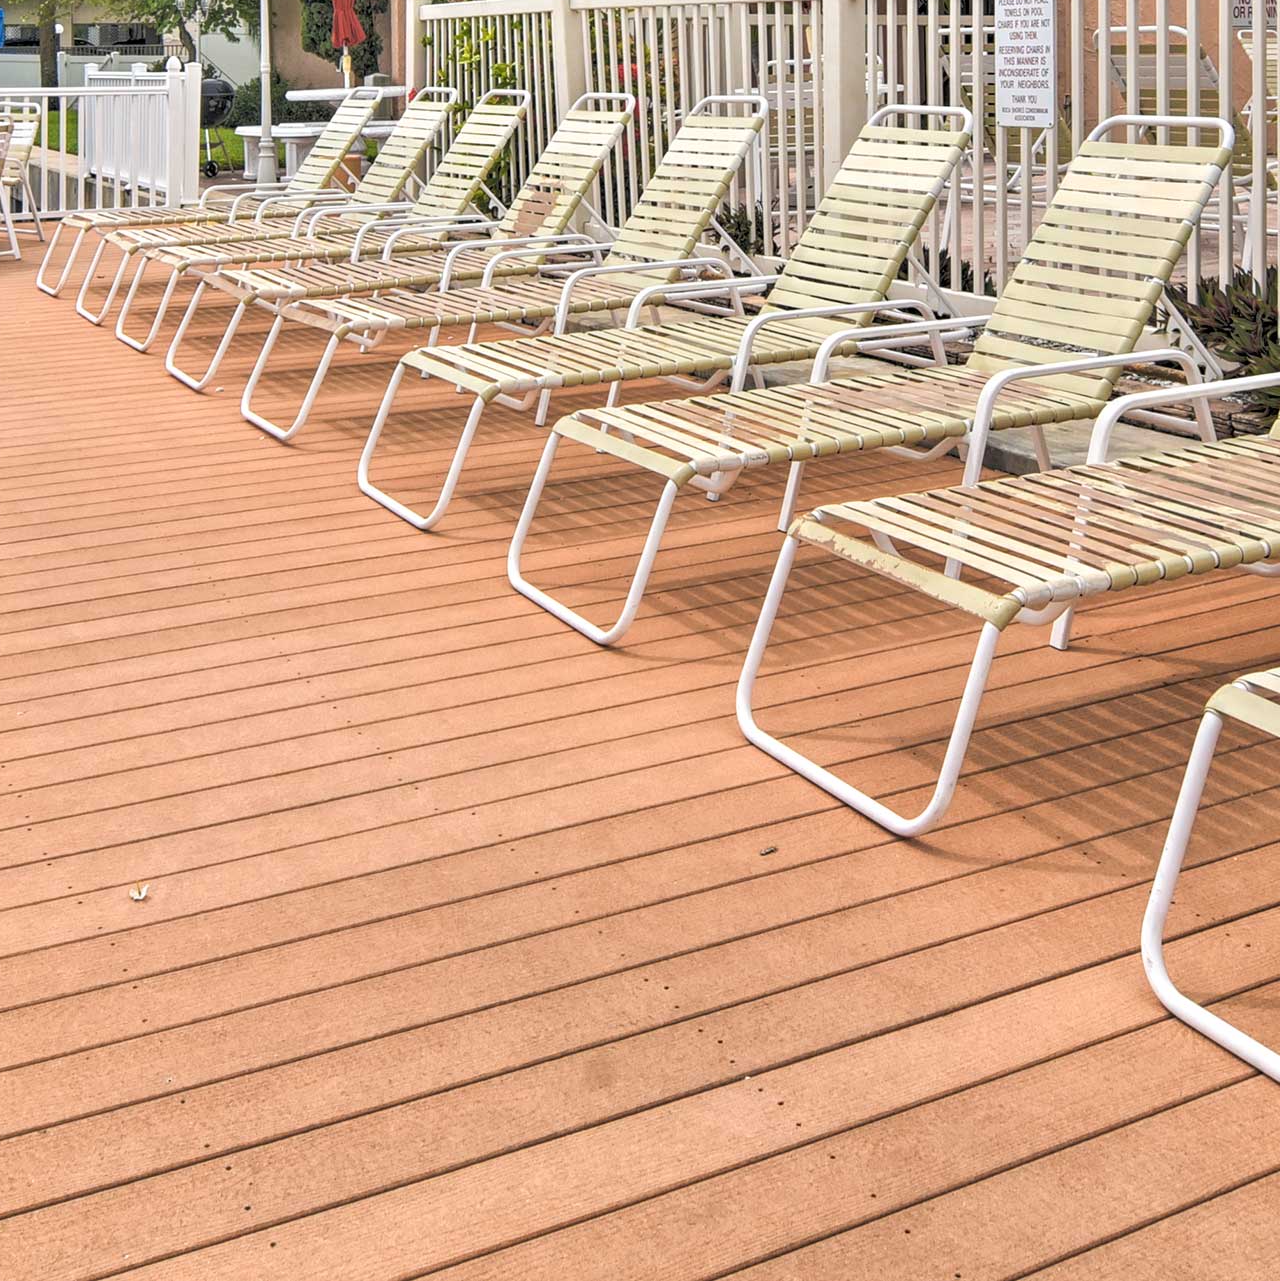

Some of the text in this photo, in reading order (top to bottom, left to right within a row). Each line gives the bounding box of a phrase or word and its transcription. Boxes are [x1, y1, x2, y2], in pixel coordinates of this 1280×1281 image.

[1004, 7, 1043, 17] TOWELS ON POOL
[1233, 6, 1246, 18] OR
[997, 18, 1050, 29] CHAIRS IF YOU ARE NOT
[1009, 31, 1024, 40] USING
[998, 45, 1051, 54] RESERVING CHAIRS IN
[1004, 56, 1046, 65] THIS MANNER IS
[999, 68, 1049, 77] INCONSIDERATE OF
[1000, 80, 1049, 89] YOUR NEIGHBORS.
[1011, 95, 1038, 104] THANK YOU
